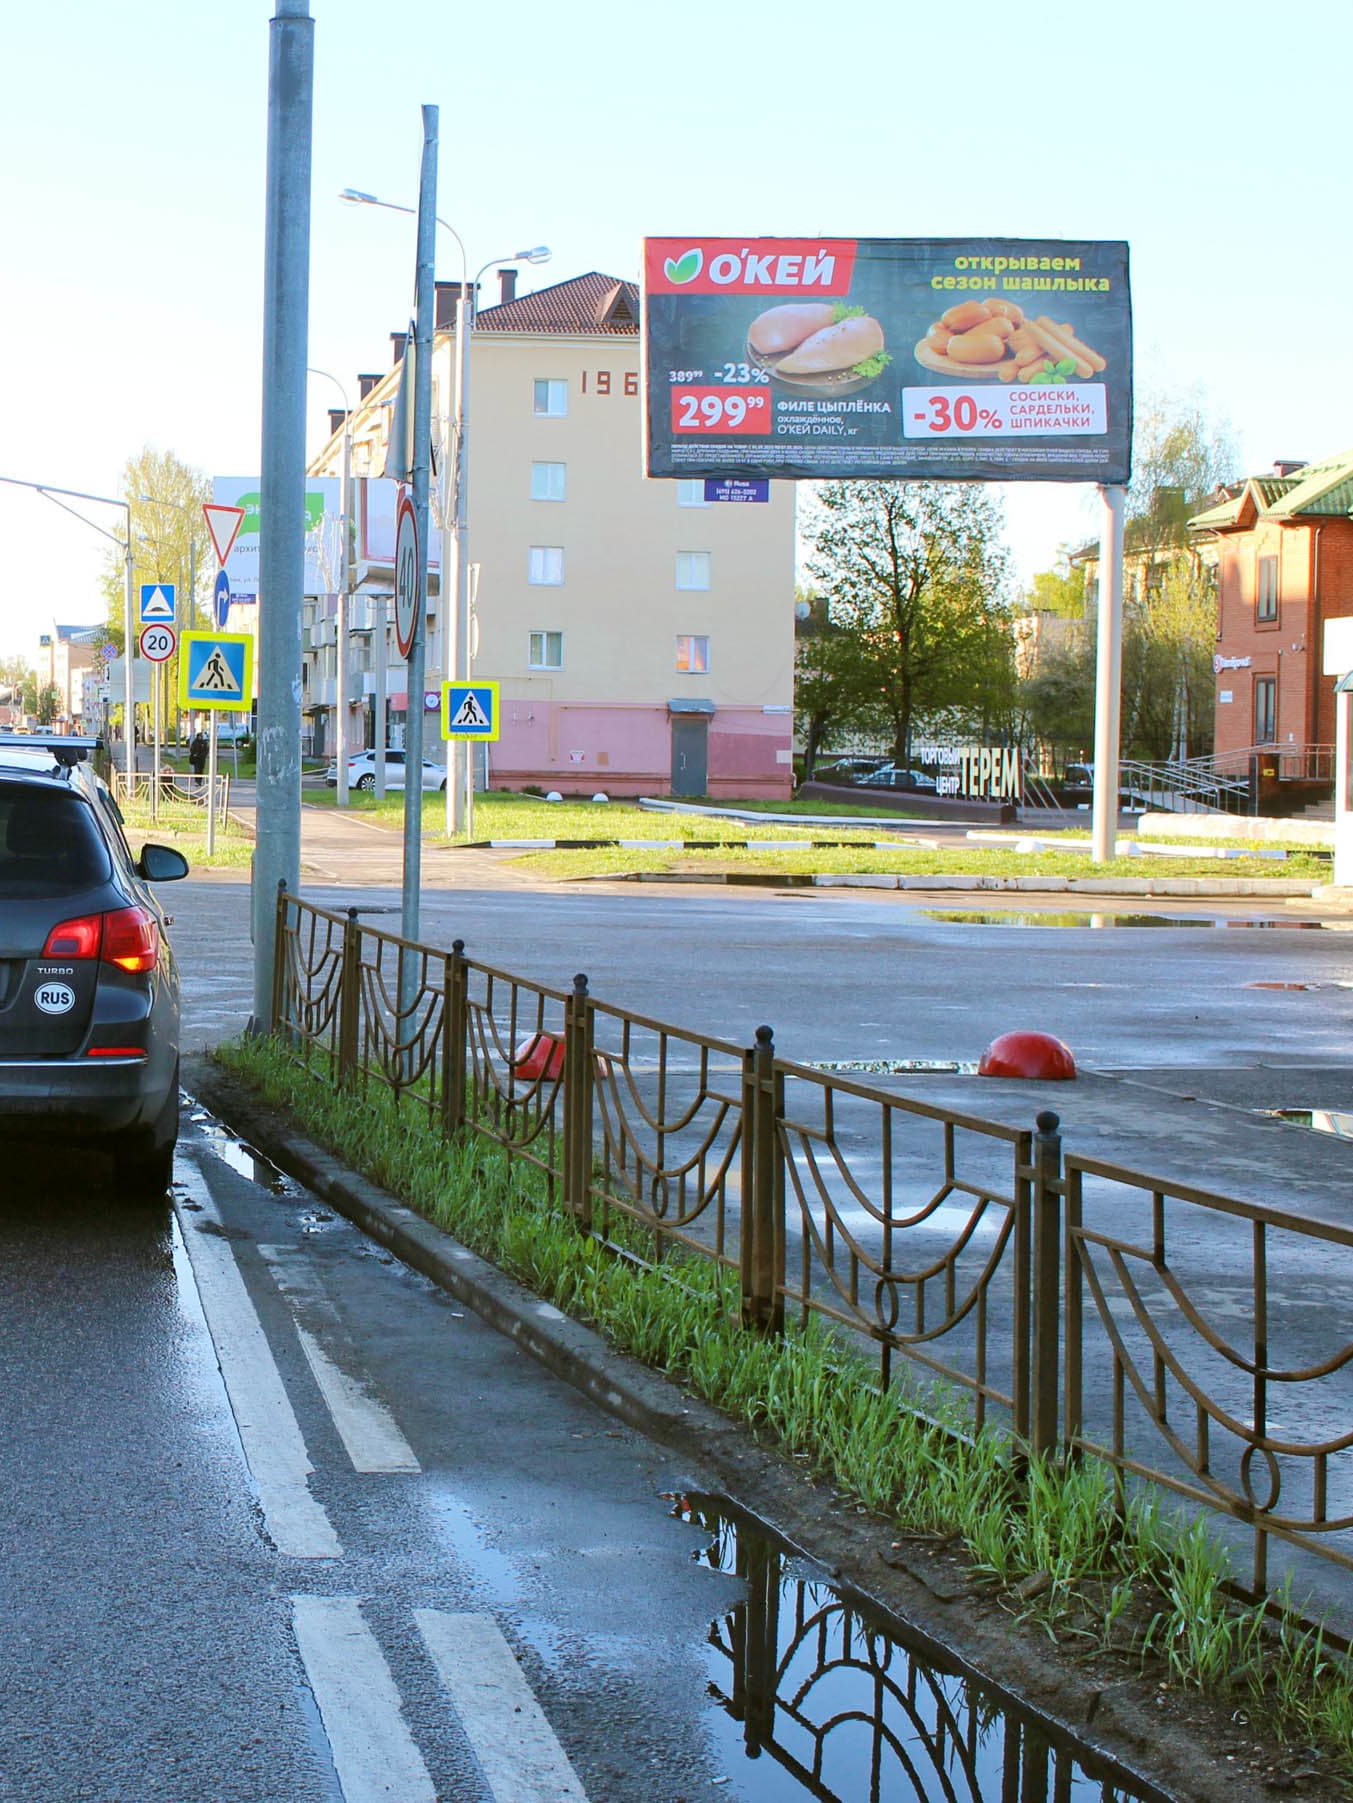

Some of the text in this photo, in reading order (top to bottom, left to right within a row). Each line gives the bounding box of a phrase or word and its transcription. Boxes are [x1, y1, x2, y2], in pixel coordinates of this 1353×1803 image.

[954, 256, 1081, 274] открываем
[931, 276, 1110, 292] сезон шашлыка
[714, 363, 770, 384] -23%
[1009, 391, 1080, 403] СОСИСКИ,
[777, 399, 892, 414] ФИЛЕ ЦЫПЛЁНКА
[914, 395, 1003, 432] -30%
[1009, 404, 1096, 416] САРДЕЛЬКИ,
[777, 415, 844, 425] охлаждённое,
[1010, 417, 1091, 429] ШПИКАЧКИ
[812, 426, 847, 437] DAILY,
[399, 546, 414, 608] 40
[148, 635, 168, 650] 20
[921, 746, 960, 765] ТОРГОВЫЙ
[960, 746, 1020, 798] ТЕРЕМ
[936, 776, 960, 796] ЦЕНТР
[37, 967, 74, 975] TURBO
[41, 991, 70, 1005] RUS
